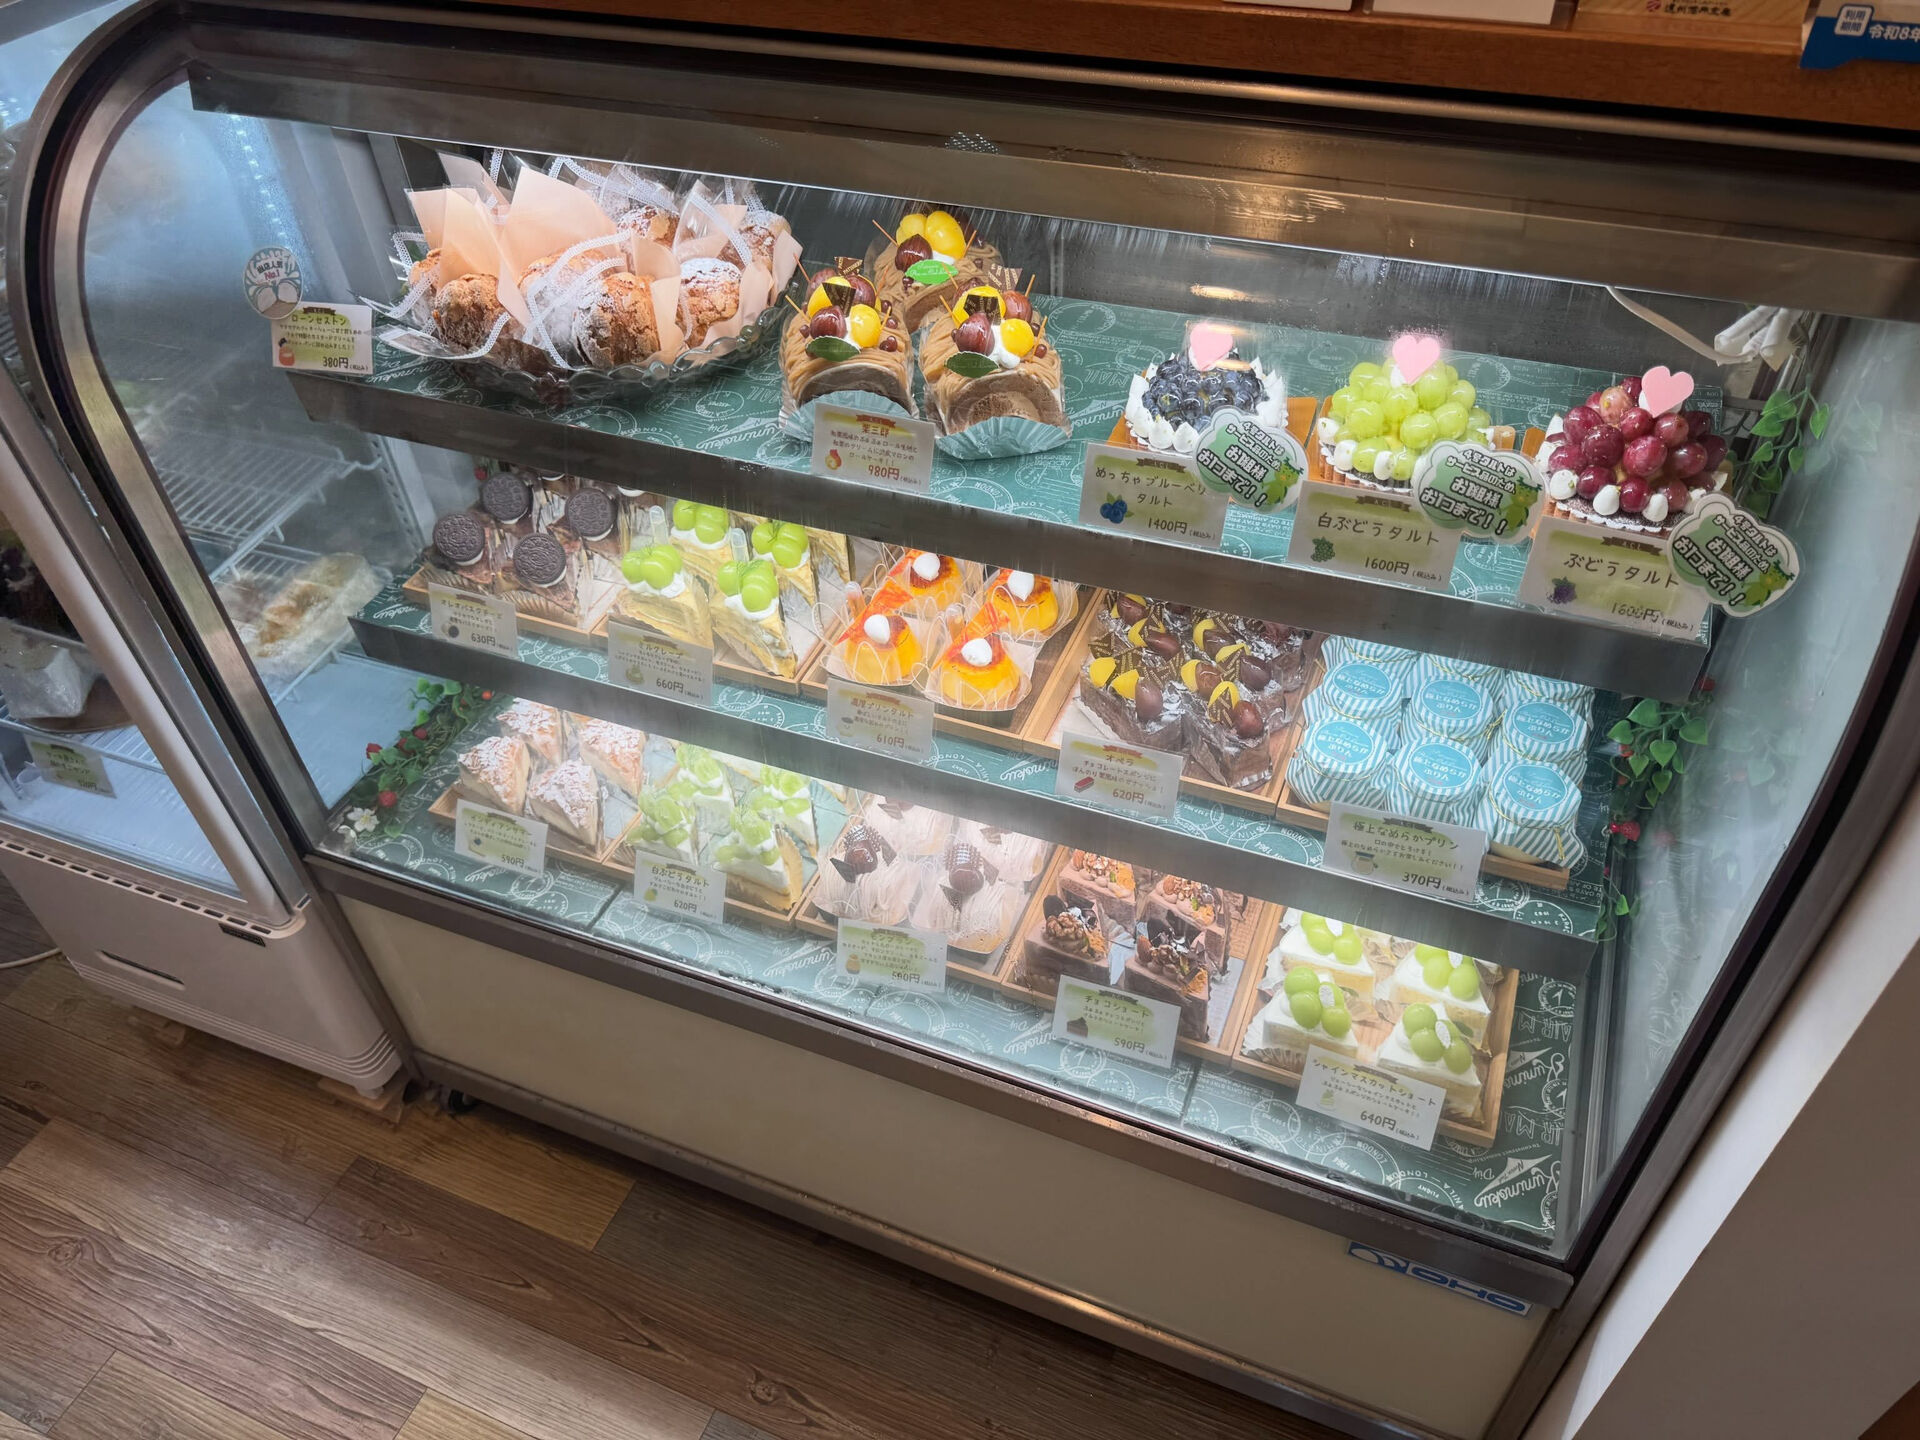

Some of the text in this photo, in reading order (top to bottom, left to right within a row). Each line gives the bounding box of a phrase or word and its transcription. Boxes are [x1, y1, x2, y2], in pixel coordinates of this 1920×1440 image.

[1844, 9, 1867, 21] 利用
[322, 356, 349, 369] 380円
[868, 464, 900, 480] 980円
[1095, 466, 1207, 496] めっちゃブルーベリ
[1136, 493, 1173, 507] タルト
[1148, 518, 1188, 535] 1400円
[1317, 512, 1440, 547] 白ぶどうタルト
[1364, 556, 1410, 576] 1600円
[1563, 552, 1680, 589] ぶどうタルト
[1610, 602, 1660, 624] 1600円
[471, 632, 496, 647] 630円
[656, 677, 684, 694] 660円
[876, 734, 905, 749] 610円
[1112, 787, 1144, 804] 620円
[1353, 820, 1459, 850] 極上なめらかプリン
[1402, 871, 1442, 889] 370円
[674, 899, 698, 913] 620円
[1114, 1037, 1145, 1054] 590円
[1504, 1053, 1565, 1088] Kumimo
[1313, 1058, 1437, 1107] シャインマスカットショート
[1360, 1111, 1396, 1131] 640円
[1472, 1166, 1495, 1181] Diy
